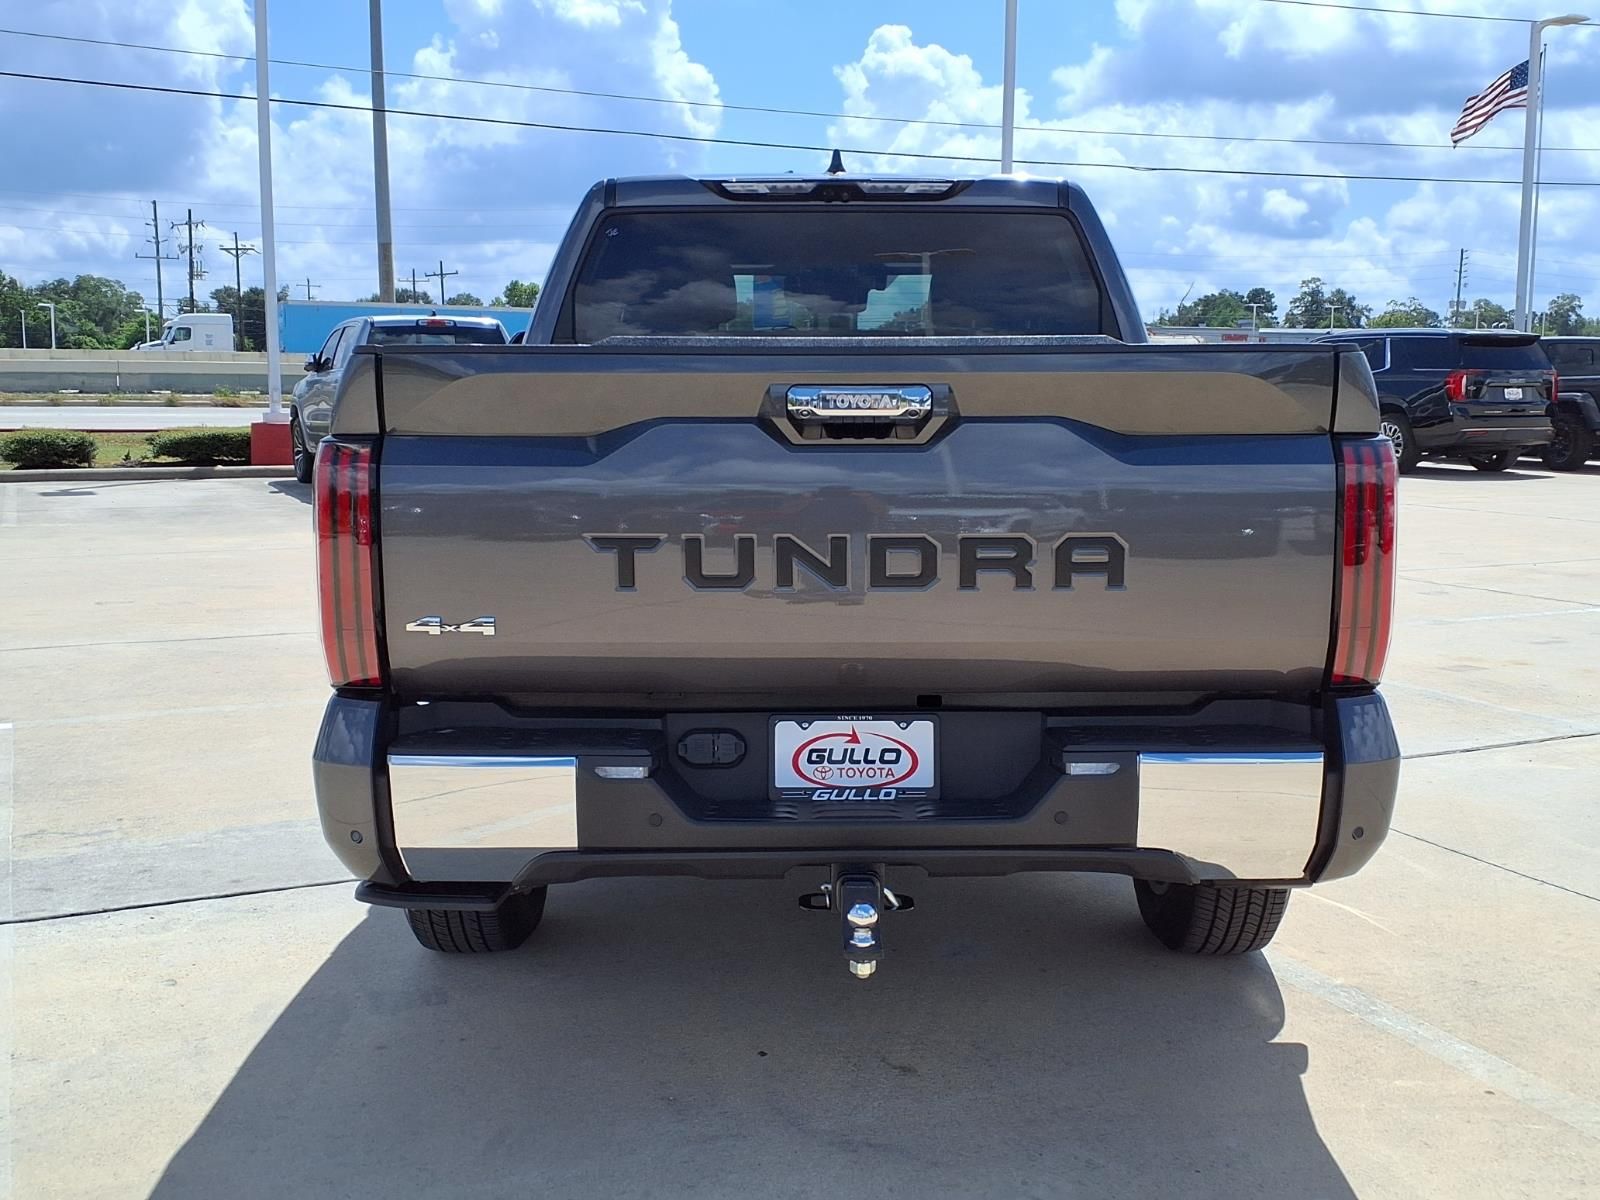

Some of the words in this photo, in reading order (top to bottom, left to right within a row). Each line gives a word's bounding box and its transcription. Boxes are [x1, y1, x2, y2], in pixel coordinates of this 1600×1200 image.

[826, 394, 894, 409] TOYOTA
[582, 532, 1130, 592] TUNDRA
[806, 747, 902, 765] GULLO
[836, 767, 895, 779] TOYOTA
[811, 788, 897, 801] GULLO
